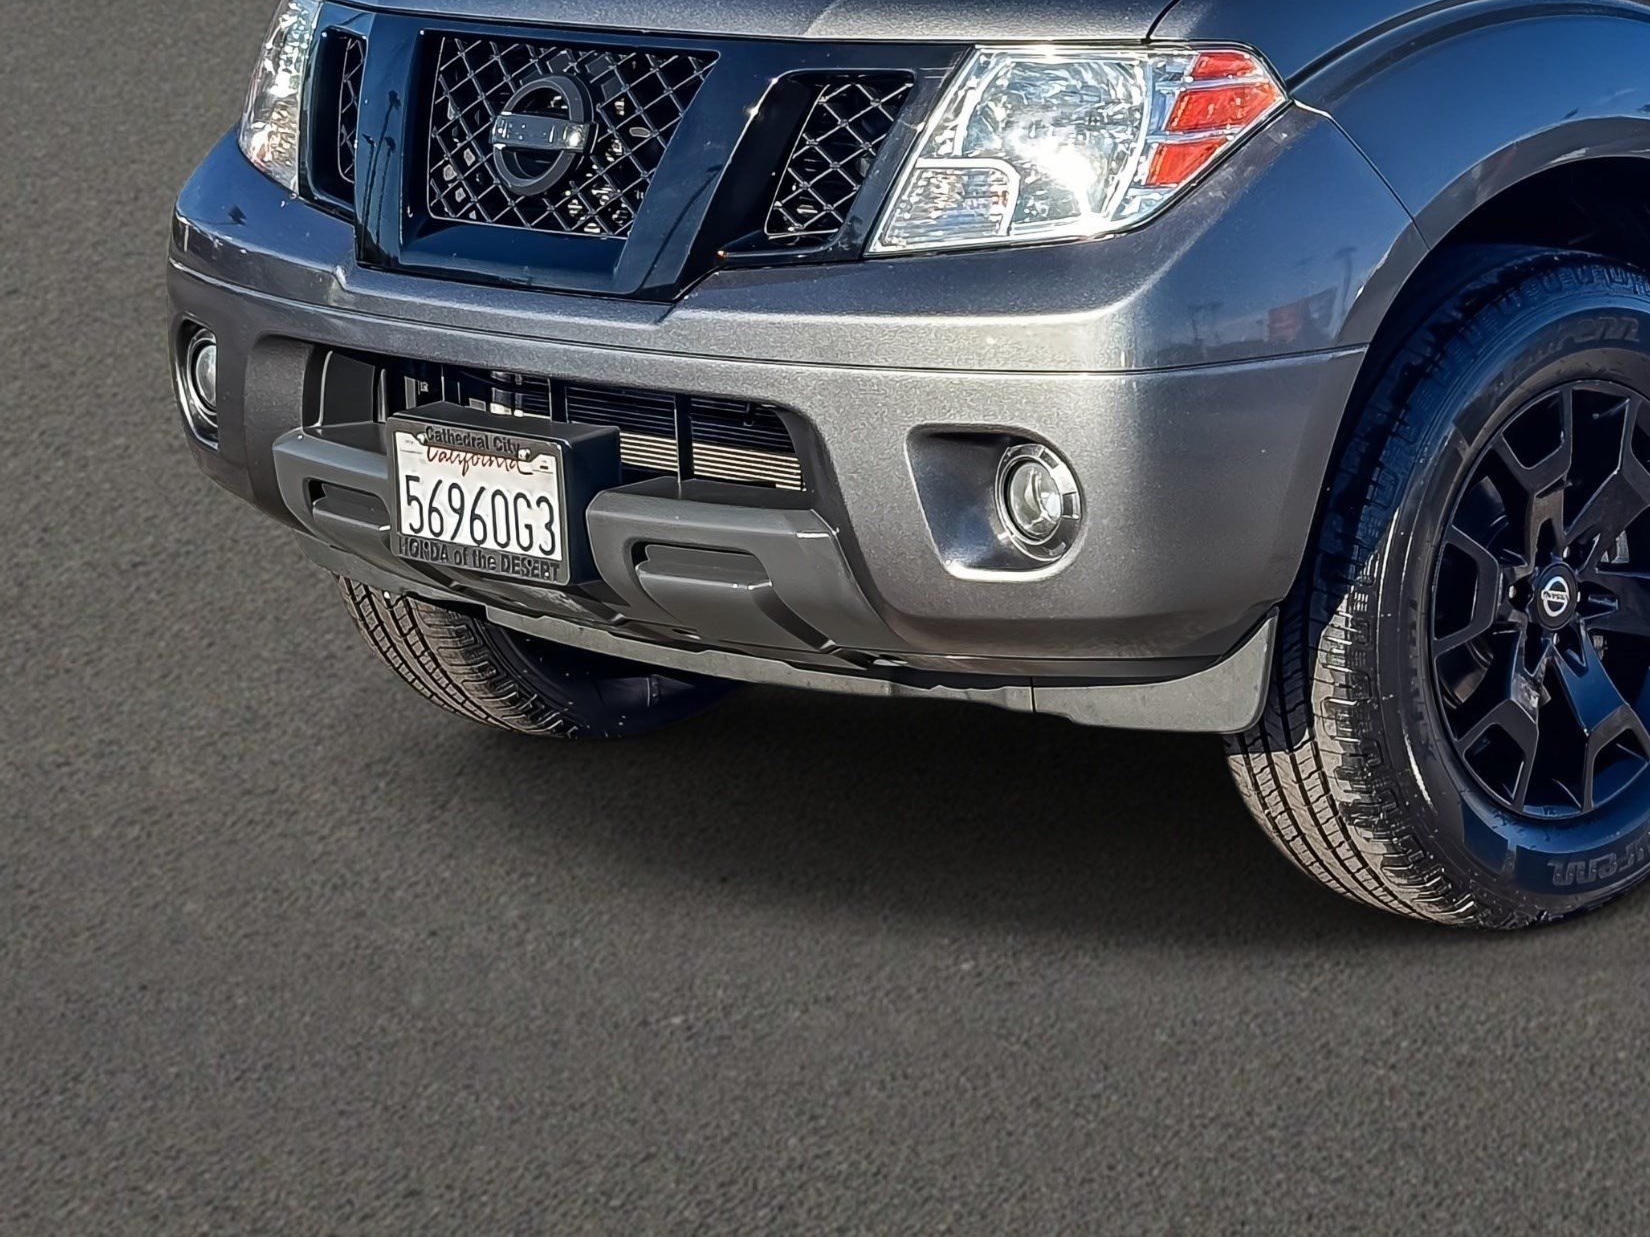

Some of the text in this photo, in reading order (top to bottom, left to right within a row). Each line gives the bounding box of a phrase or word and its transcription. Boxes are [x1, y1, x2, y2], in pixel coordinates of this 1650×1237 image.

[425, 425, 520, 454] Cathedral City
[400, 536, 449, 562] HONDA
[453, 546, 467, 566] of
[472, 547, 497, 571] the
